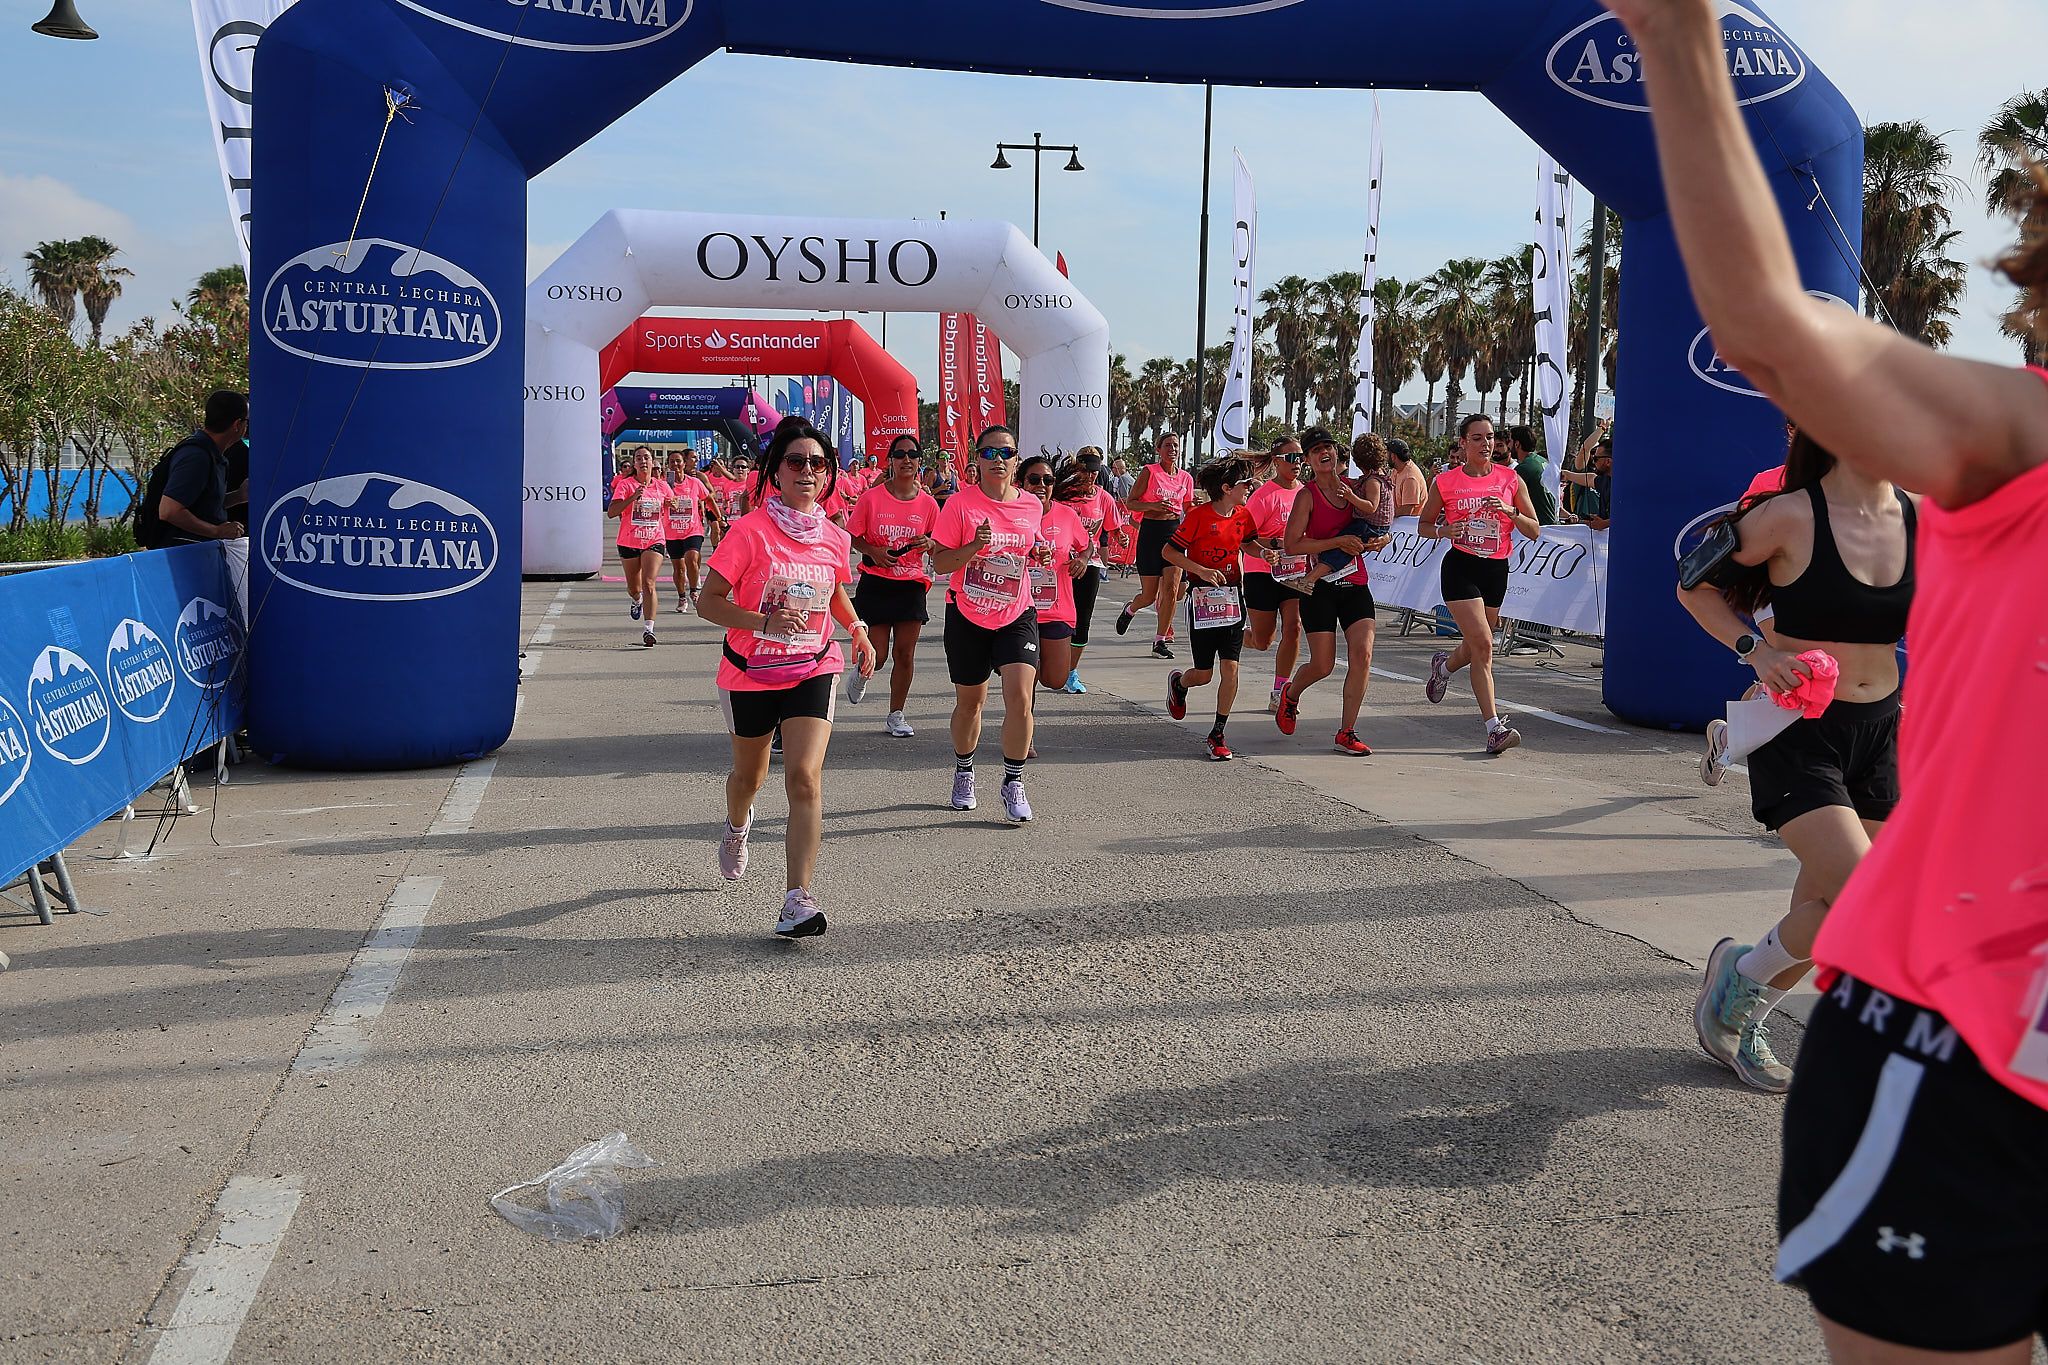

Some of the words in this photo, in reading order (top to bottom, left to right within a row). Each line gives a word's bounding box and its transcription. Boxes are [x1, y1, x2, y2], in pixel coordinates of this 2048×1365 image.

[1722, 29, 1779, 45] ECHERA
[697, 231, 938, 286] OYSHO
[303, 280, 390, 296] CENTRAL
[399, 286, 482, 307] LECHERA
[547, 284, 623, 303] OYSHO
[1004, 294, 1073, 309] OYSHO
[272, 283, 489, 346] ASTURIANA
[645, 330, 702, 352] Sports
[730, 332, 820, 350] Santander
[701, 355, 760, 363] sportssantander.es
[659, 393, 690, 402] octopus
[690, 394, 717, 403] energy
[1039, 393, 1102, 409] OYSHO
[882, 413, 908, 424] Sports
[303, 514, 387, 529] CENTRAL
[396, 518, 479, 533] LECHERA
[879, 524, 916, 538] CARRERA
[271, 515, 485, 570] ASTURIANA
[1468, 535, 1485, 544] 016
[770, 562, 832, 583] CARRERA
[983, 572, 1005, 585] 016
[1031, 586, 1042, 594] 16
[1208, 604, 1226, 613] 016
[43, 685, 69, 705] CENTRAL
[69, 676, 94, 694] LECHERA
[113, 656, 173, 706] ASTURIANA
[35, 690, 108, 744] ASTURIANA
[1831, 975, 1958, 1063] ARM
